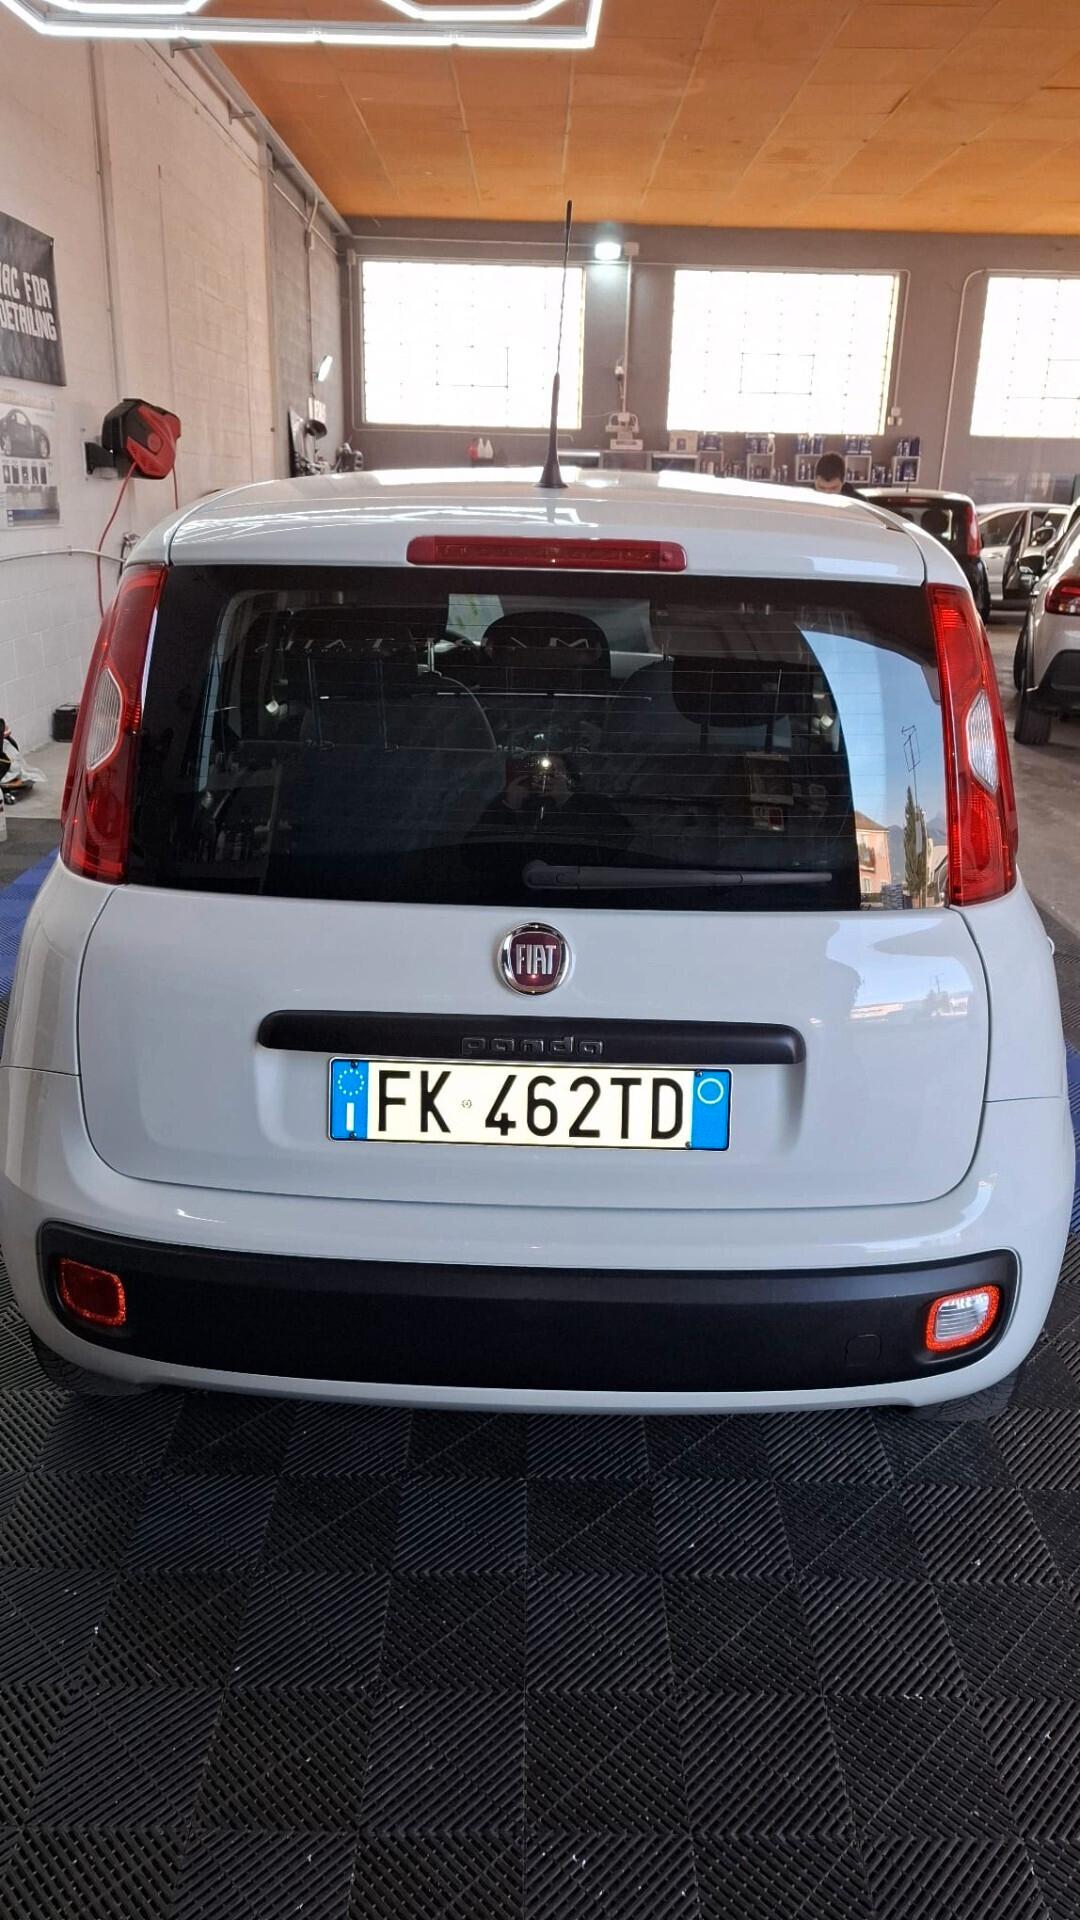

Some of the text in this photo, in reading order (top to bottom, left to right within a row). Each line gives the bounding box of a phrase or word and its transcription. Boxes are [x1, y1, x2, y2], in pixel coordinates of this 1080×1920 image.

[0, 262, 52, 308] AC FOR
[515, 943, 557, 975] FIAT
[461, 1036, 604, 1056] panda
[378, 1069, 684, 1140] FK 462TD
